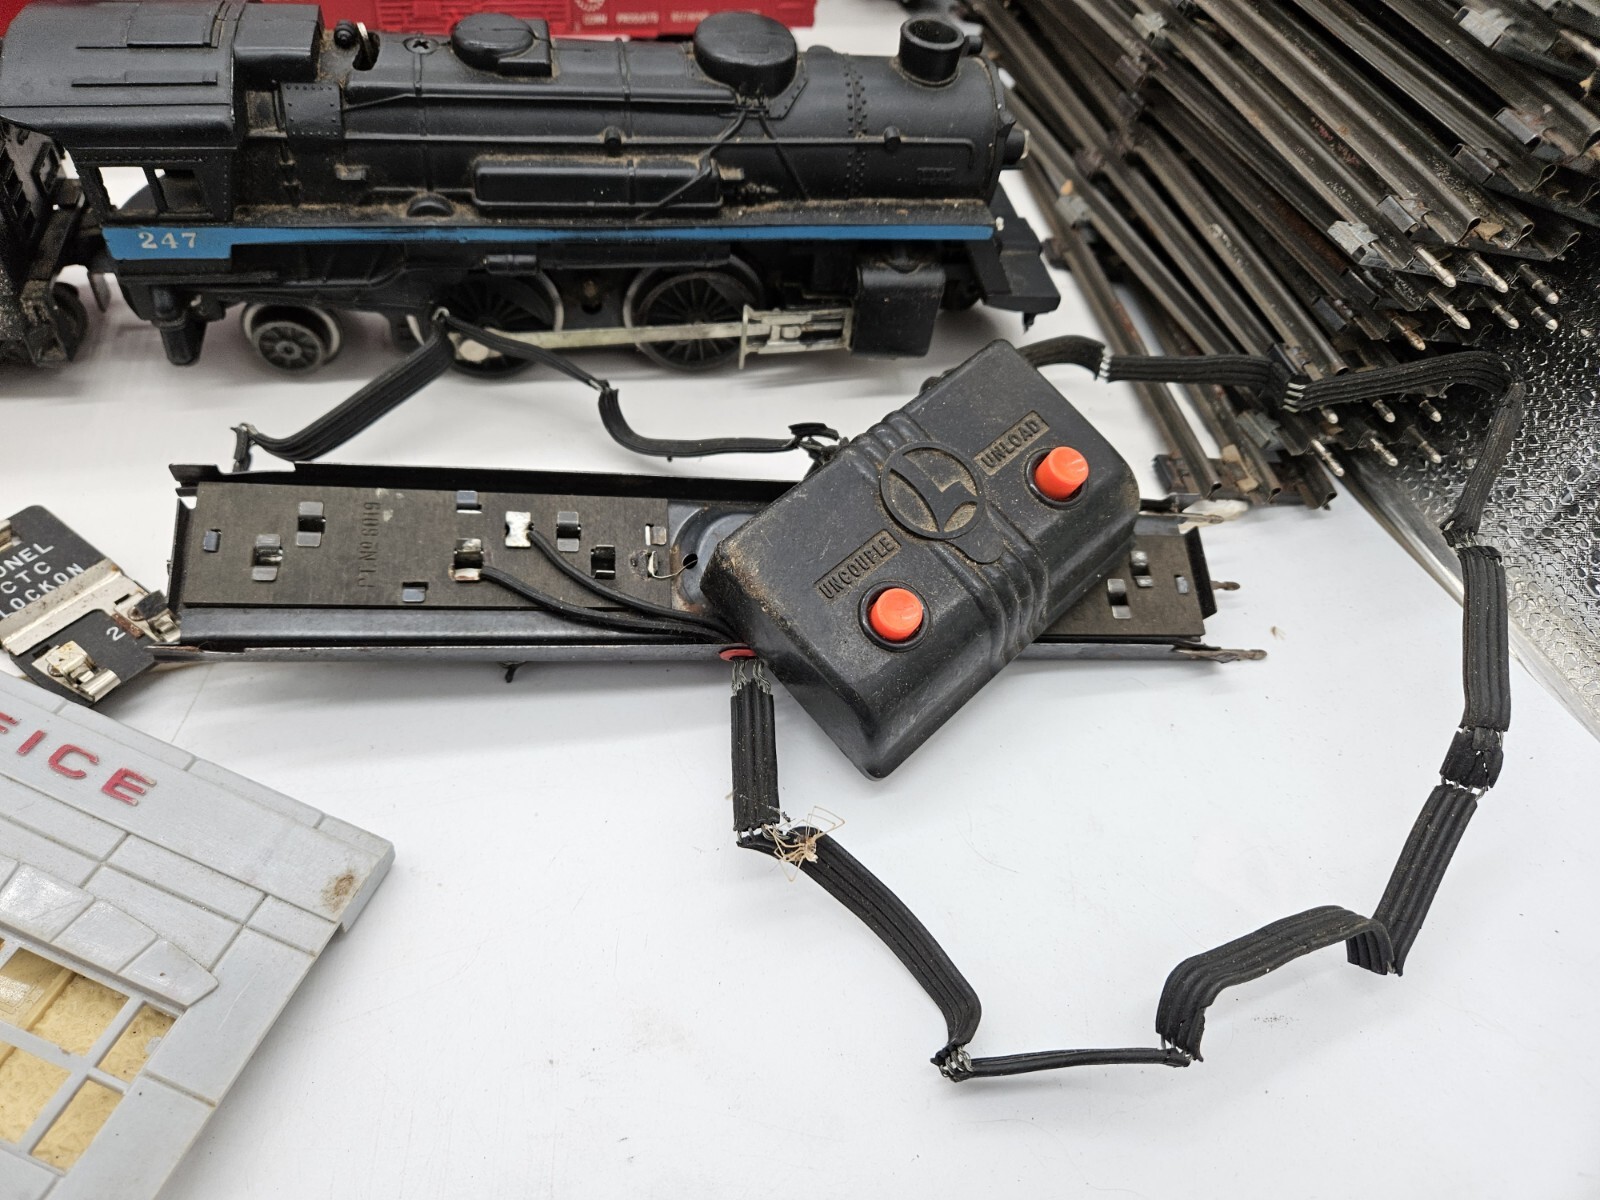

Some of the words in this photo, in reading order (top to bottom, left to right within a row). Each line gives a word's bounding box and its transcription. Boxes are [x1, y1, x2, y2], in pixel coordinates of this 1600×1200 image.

[138, 231, 197, 249] 247
[980, 419, 1040, 468] UNLOAD
[818, 536, 895, 599] UNCOUPLE
[106, 625, 126, 641] 2
